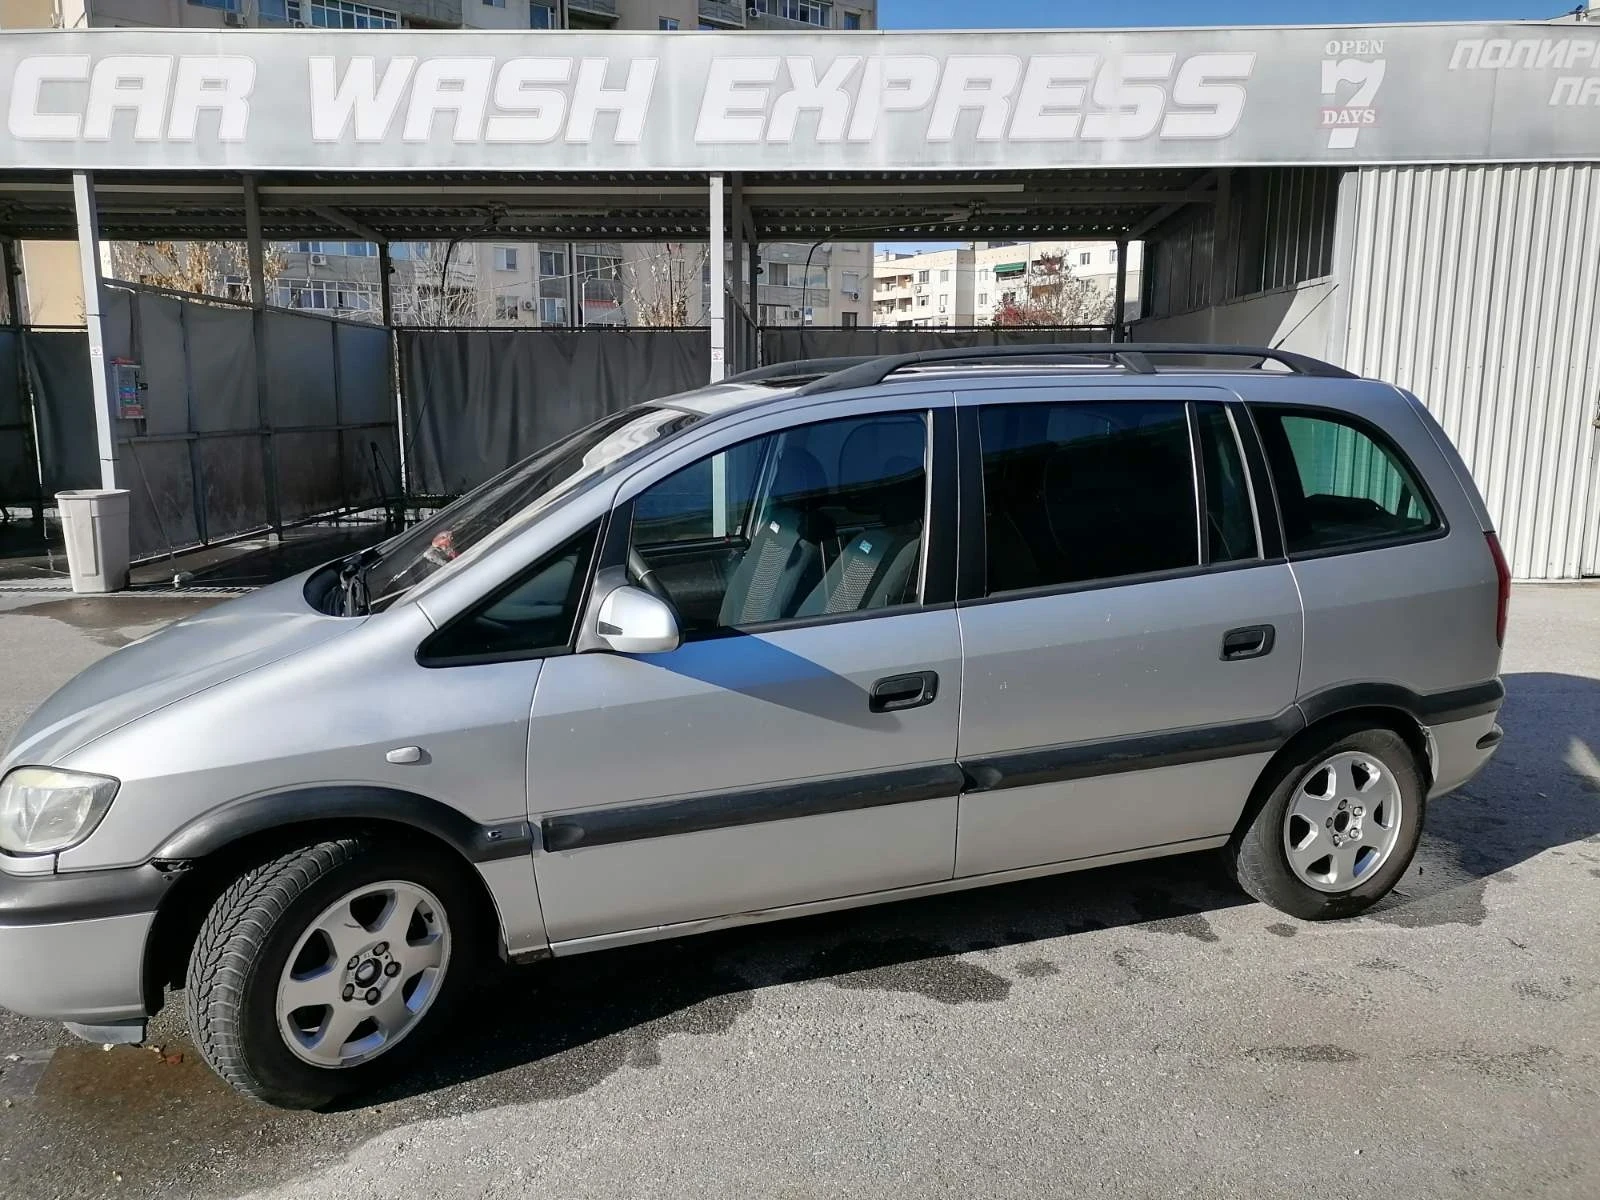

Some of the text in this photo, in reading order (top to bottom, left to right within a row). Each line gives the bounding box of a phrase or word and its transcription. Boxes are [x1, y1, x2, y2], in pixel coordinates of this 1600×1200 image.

[1325, 39, 1385, 55] OPEN
[8, 51, 1257, 144] CAR WASH EXPRESS
[1321, 58, 1386, 149] 7
[1322, 109, 1376, 125] DAYS
